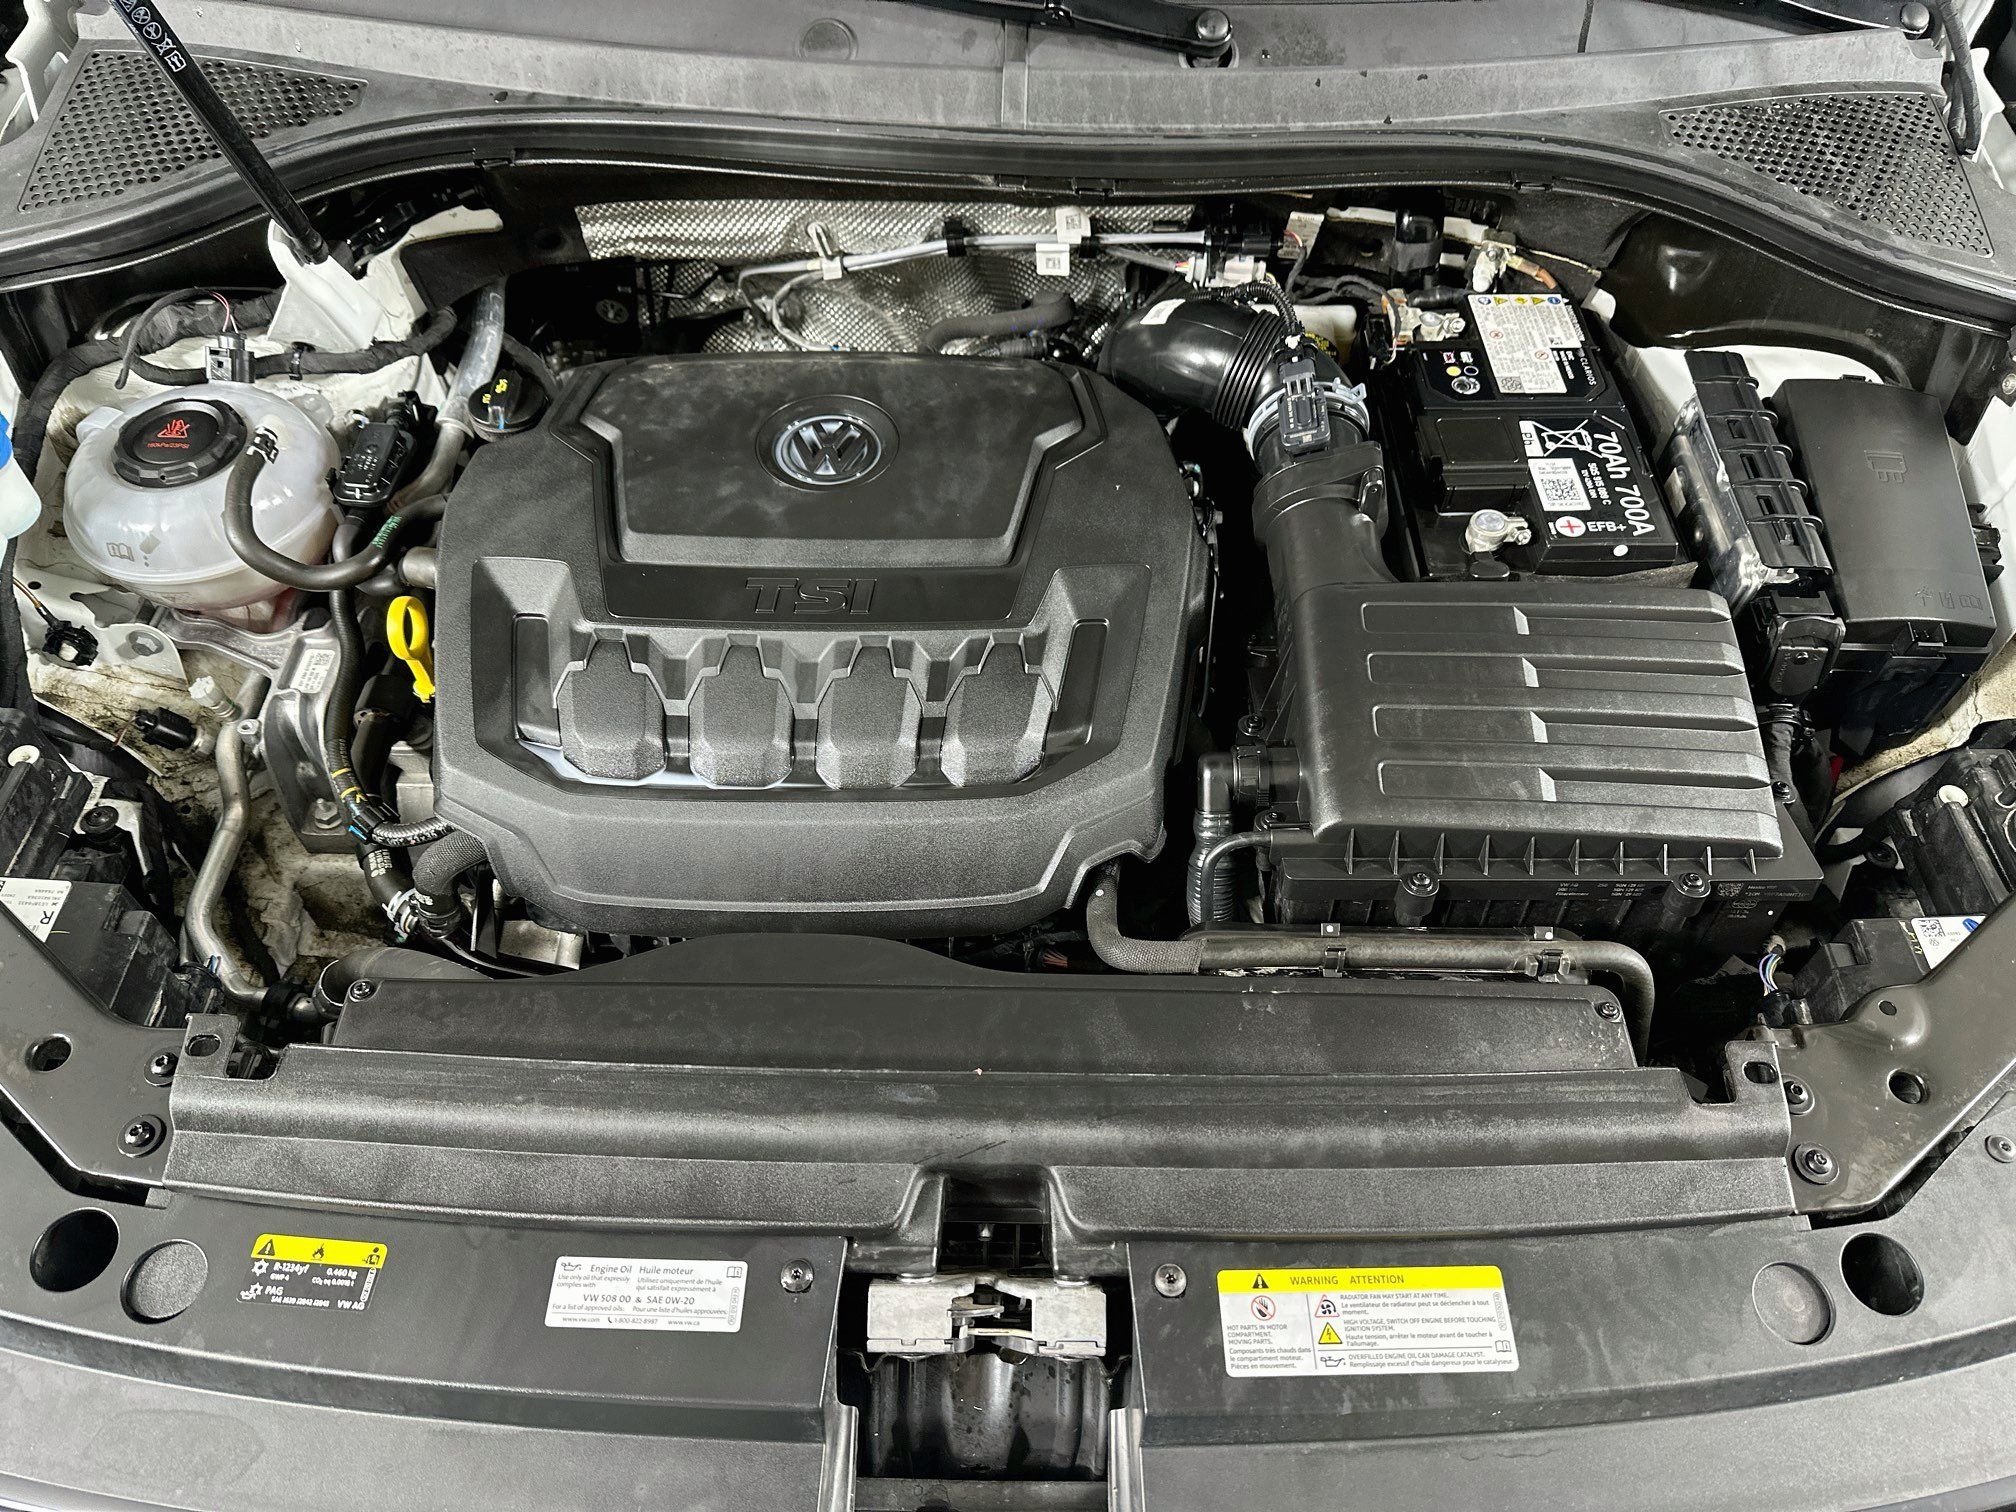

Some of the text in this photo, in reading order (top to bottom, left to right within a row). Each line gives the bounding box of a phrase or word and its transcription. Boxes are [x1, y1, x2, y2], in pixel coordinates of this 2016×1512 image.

[1580, 357, 1597, 386] CLARIOS
[1522, 432, 1533, 446] Pb
[776, 415, 881, 485] VW
[1593, 431, 1656, 536] 70Ah 700A
[1586, 521, 1627, 532] EFB+
[745, 578, 877, 614] TSI
[40, 911, 55, 925] R
[273, 1262, 310, 1275] R-1234yf
[348, 1268, 358, 1279] kg
[590, 1264, 694, 1275] Engine Oil Huile moteur
[1289, 1274, 1405, 1286] WARNING ATTENTION
[264, 1285, 284, 1295] PAG
[337, 1299, 365, 1310] VW AG
[583, 1294, 599, 1302] VW
[601, 1294, 617, 1302] 508
[619, 1295, 631, 1303] 00
[646, 1296, 663, 1304] SAE
[665, 1297, 695, 1305] 0W-20
